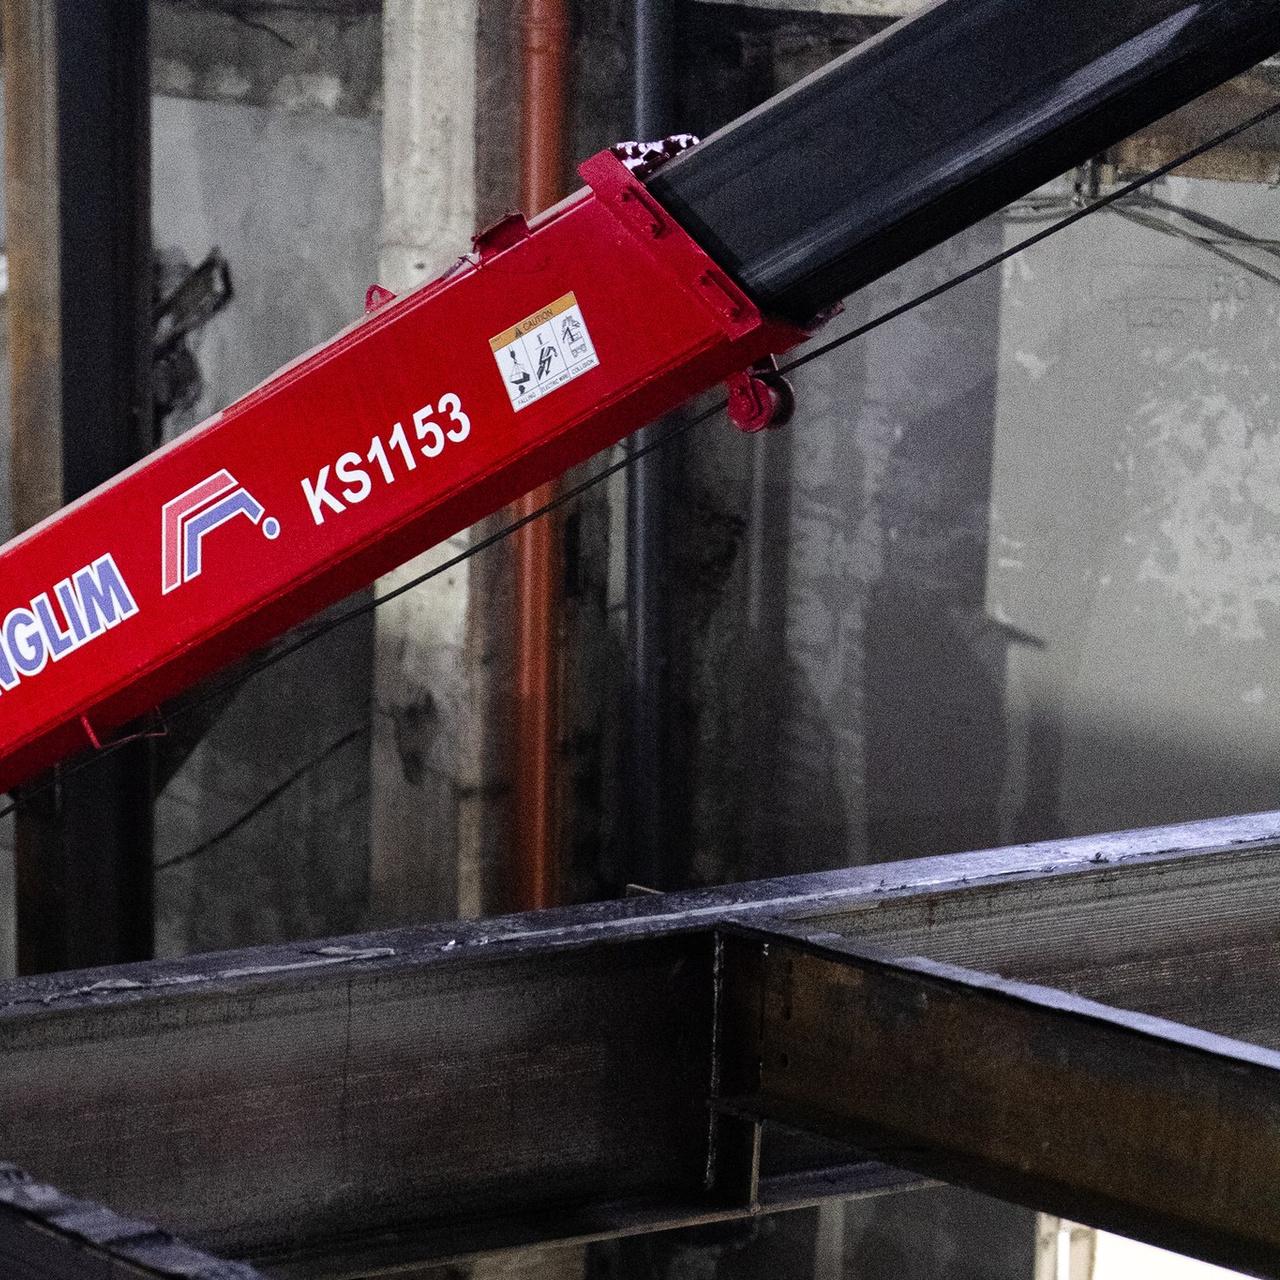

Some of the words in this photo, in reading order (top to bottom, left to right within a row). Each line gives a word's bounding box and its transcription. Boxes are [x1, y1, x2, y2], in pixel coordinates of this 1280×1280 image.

[522, 308, 554, 331] CAUTION
[571, 358, 595, 375] COLLISION
[517, 391, 537, 406] FALLING
[300, 392, 471, 526] KS1153
